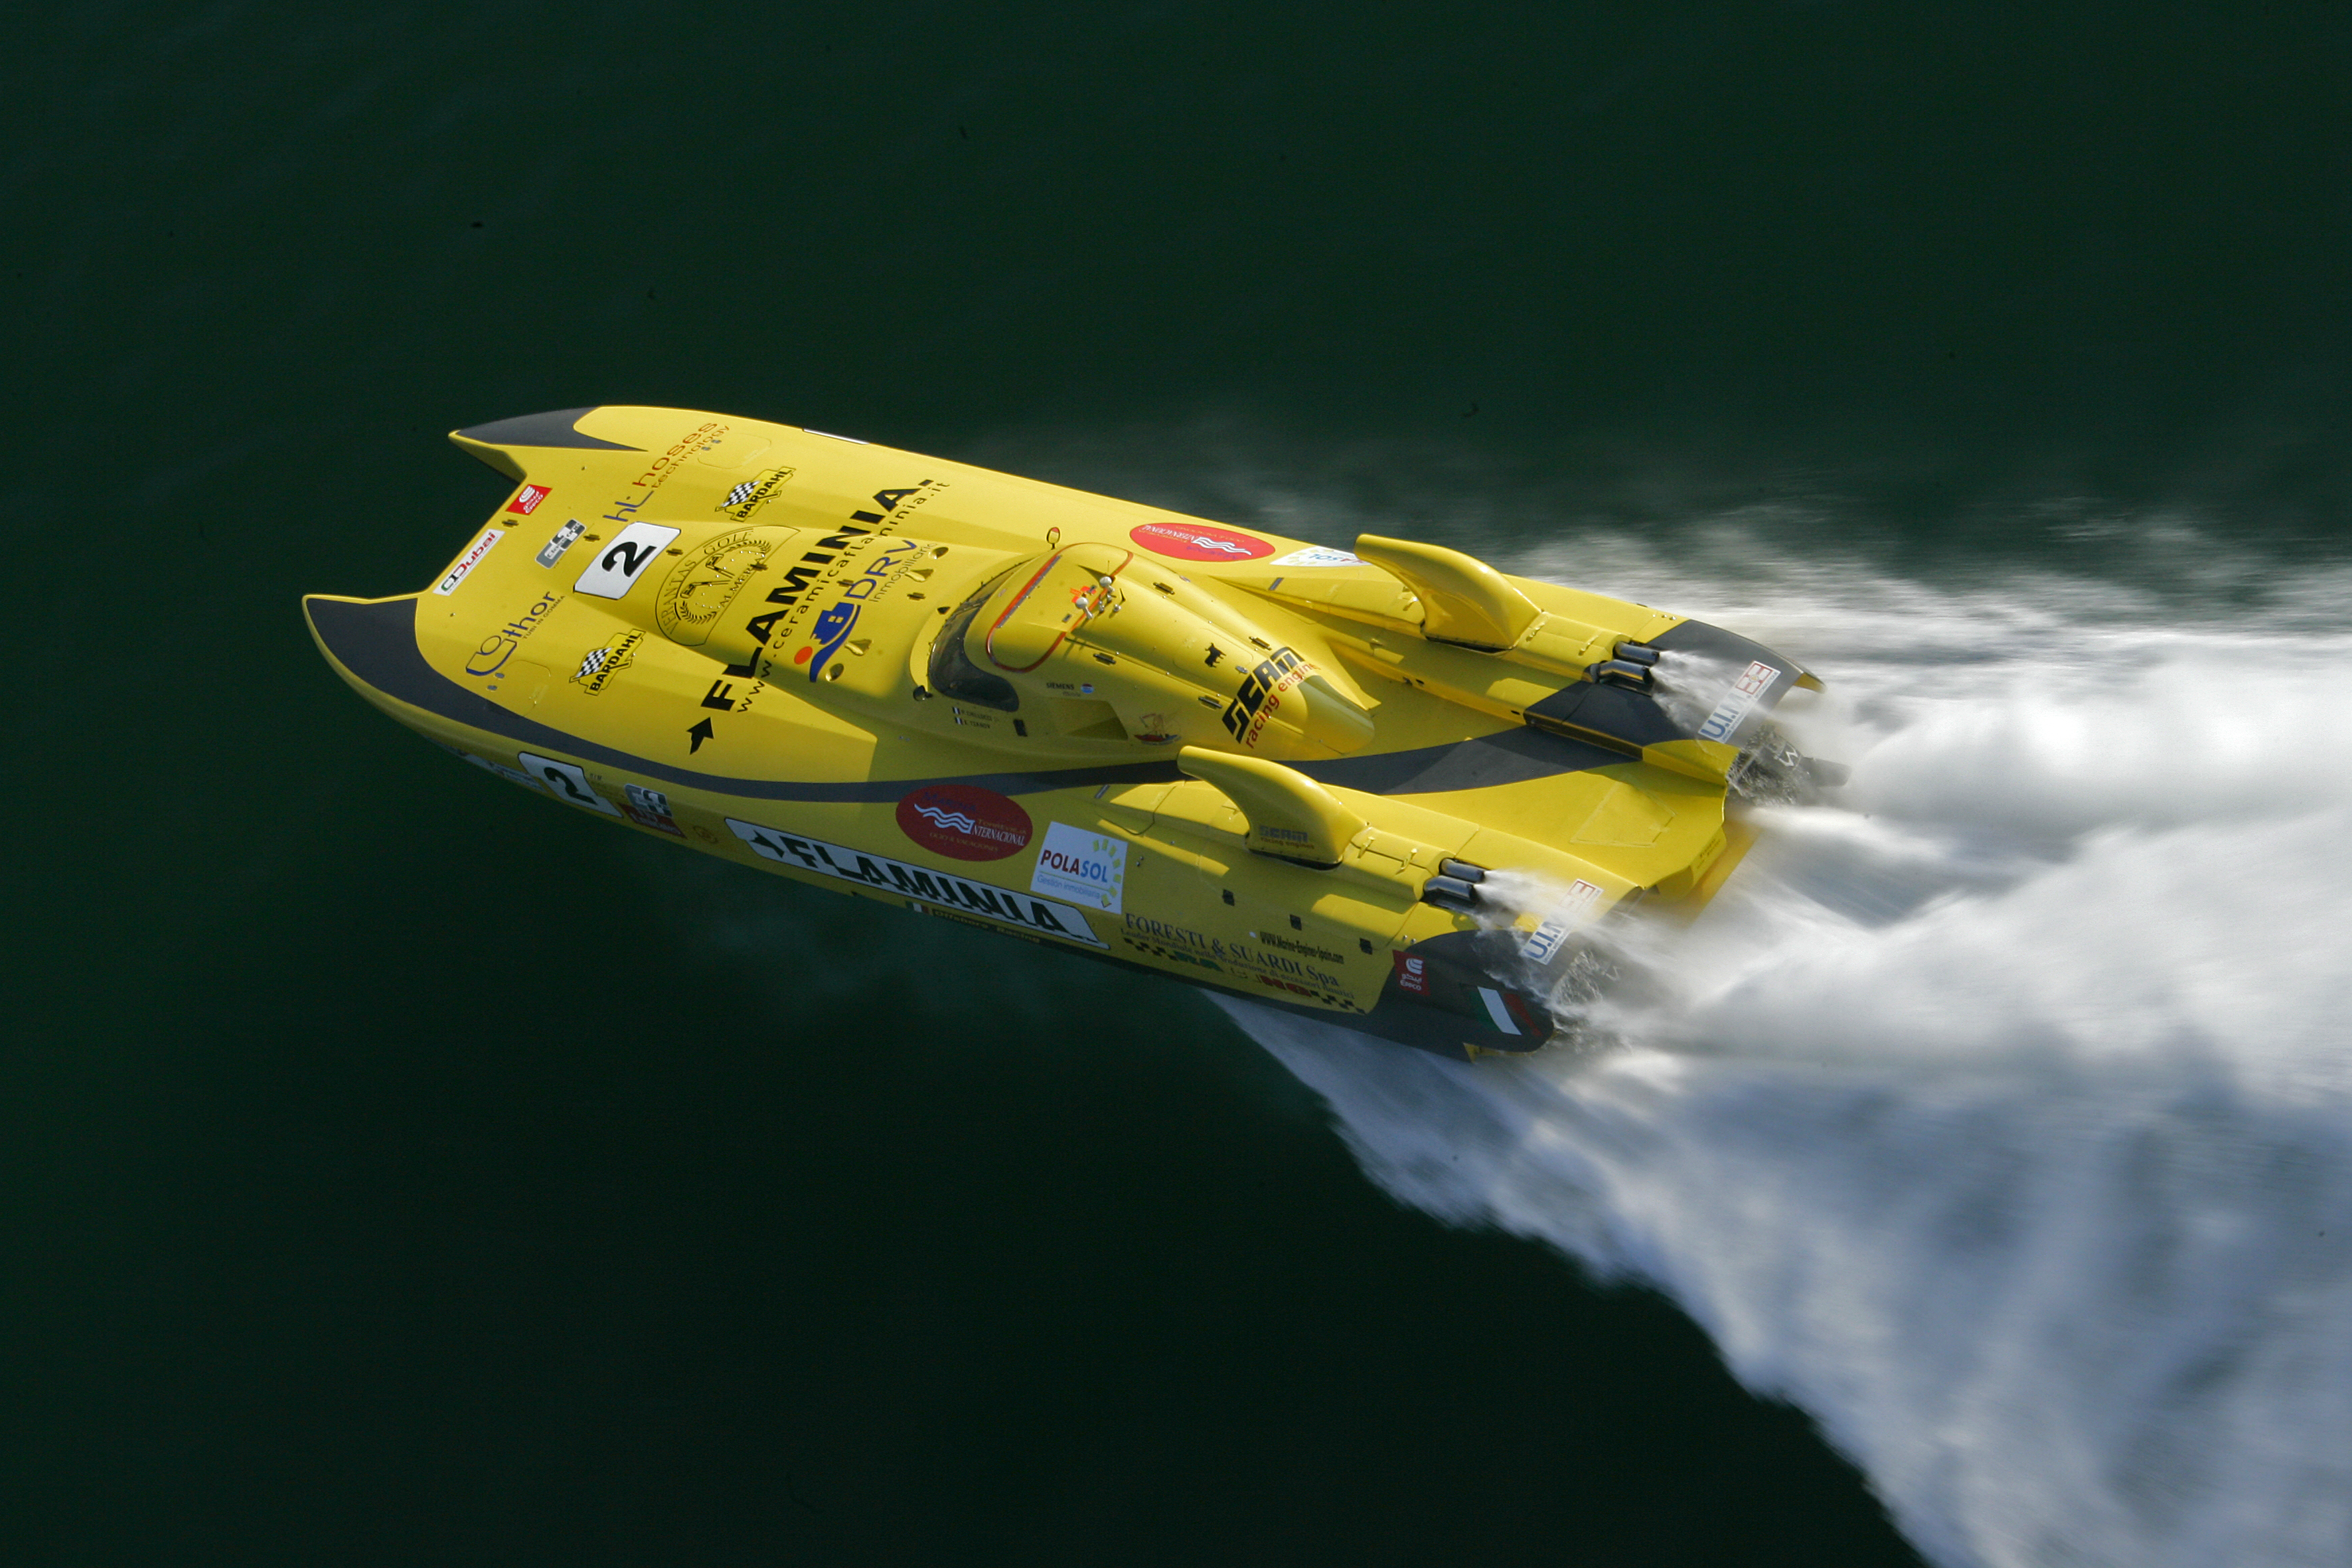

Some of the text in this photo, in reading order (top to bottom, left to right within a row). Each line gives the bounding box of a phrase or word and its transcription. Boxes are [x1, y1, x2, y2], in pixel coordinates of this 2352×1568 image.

[632, 422, 718, 487] hoses
[651, 426, 730, 488] technology
[736, 469, 793, 520] BARDAHL
[602, 540, 657, 578] 2
[704, 531, 752, 555] GOLF
[844, 540, 918, 599] DRV
[522, 626, 537, 639] TUBI
[543, 595, 566, 618] GOMMA
[737, 481, 950, 713] www.ceramicaflaminia.it
[590, 631, 642, 692] BARDAHL
[1046, 682, 1075, 690] SIEMENS
[1245, 692, 1281, 749] racing
[544, 767, 597, 805] 2
[1040, 849, 1107, 882] POLASOL
[934, 910, 1040, 944] Offshore Racing
[1125, 913, 1207, 949] FORESTI
[1212, 938, 1226, 955] &
[1229, 943, 1303, 977] SUARDI
[1306, 965, 1340, 987] Spa
